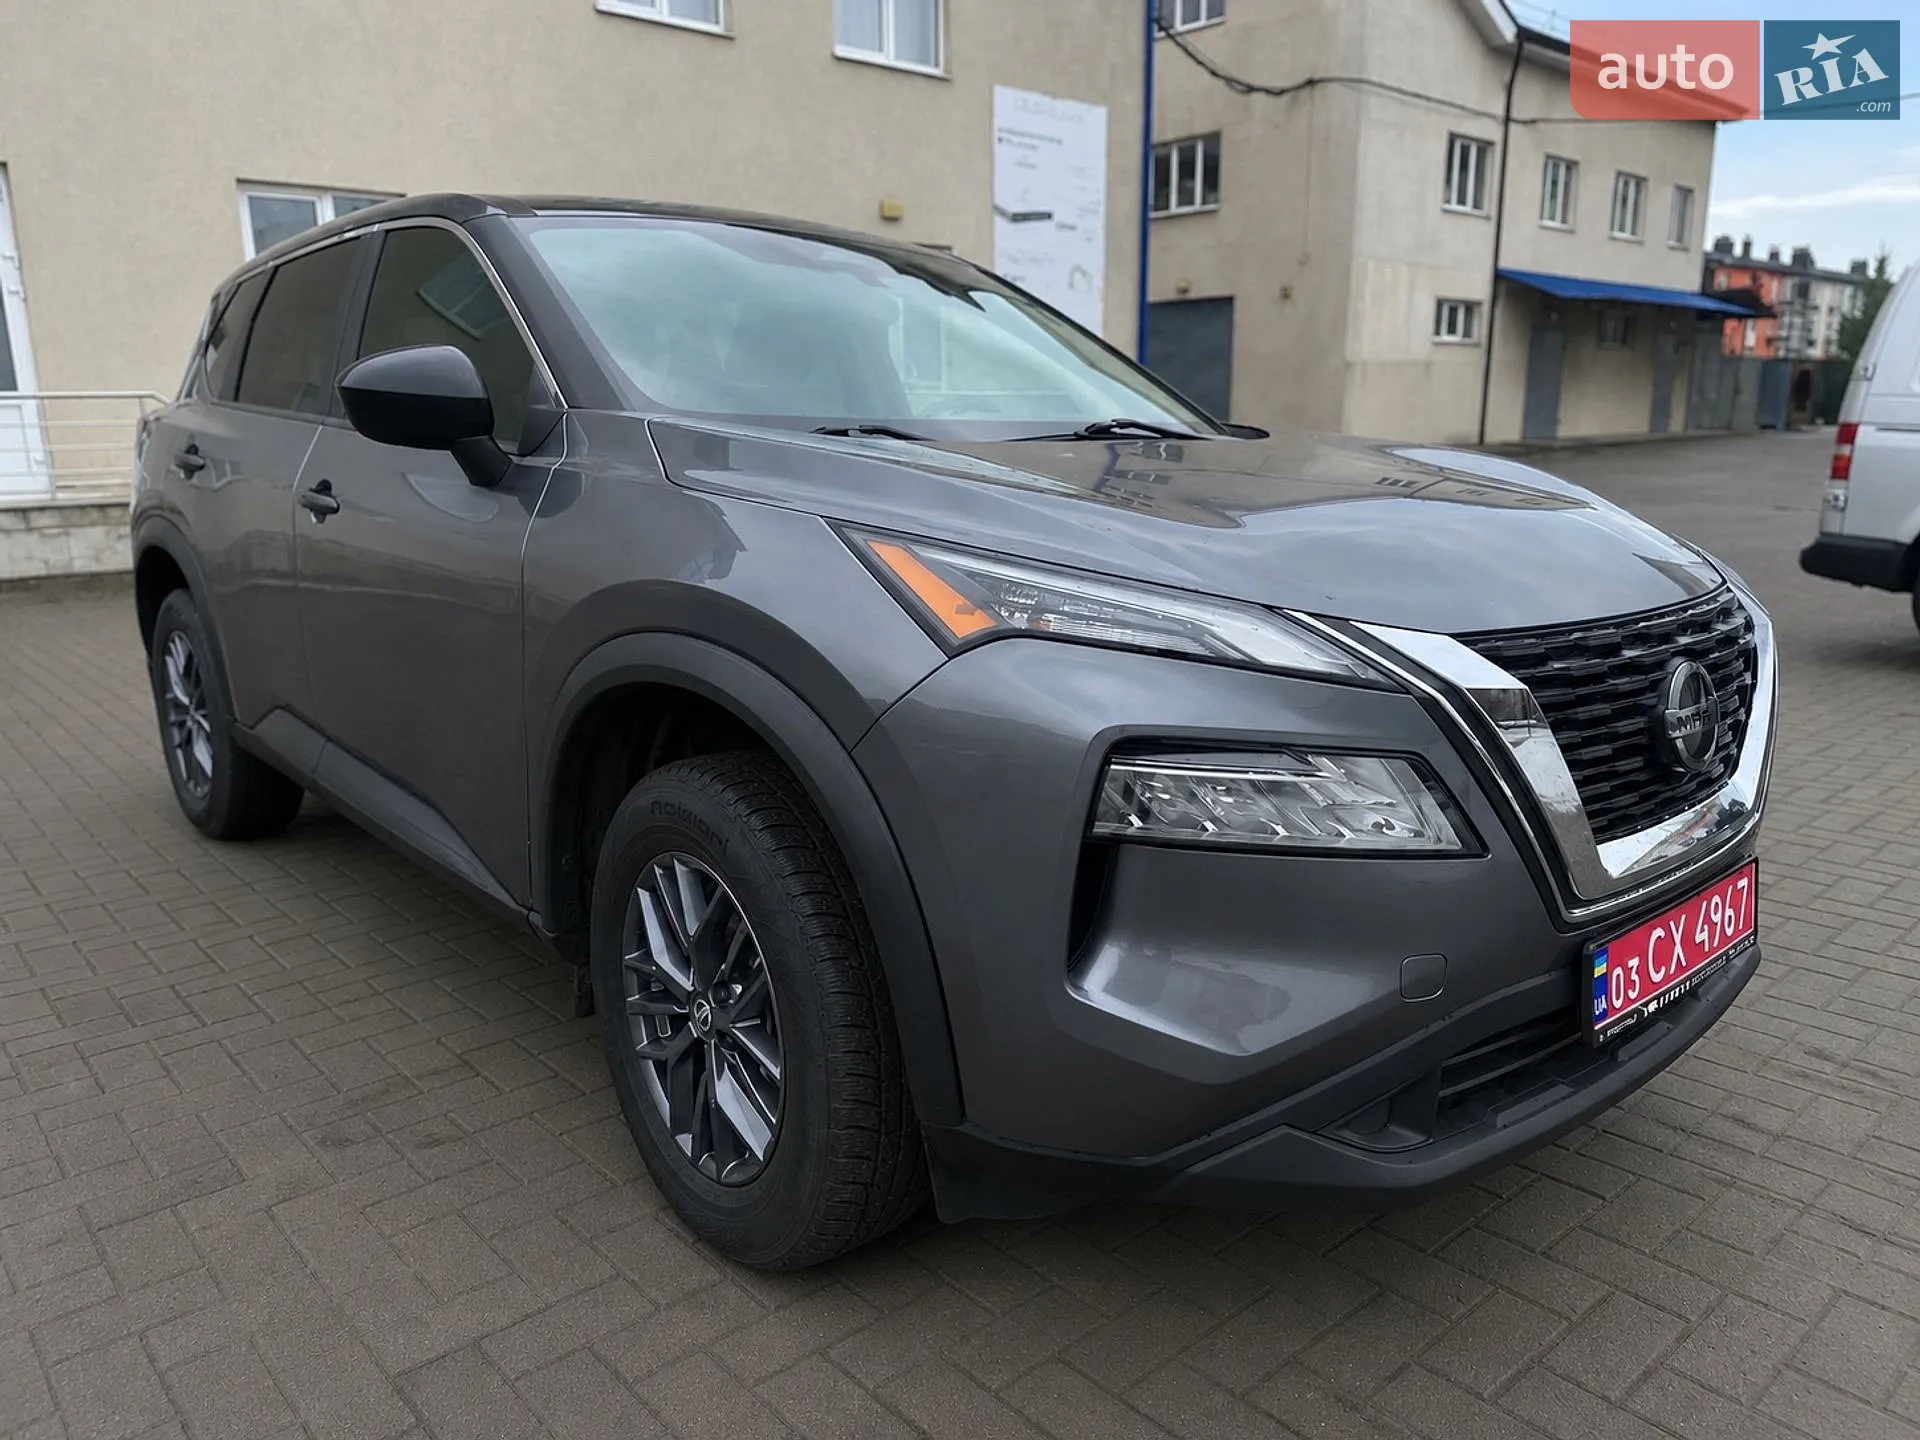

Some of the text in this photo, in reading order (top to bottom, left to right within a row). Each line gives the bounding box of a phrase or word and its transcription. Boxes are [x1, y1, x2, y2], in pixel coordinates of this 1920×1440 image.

[1611, 956, 1640, 1009] 03
[1647, 913, 1687, 984] CX
[1694, 876, 1749, 952] 4967
[1593, 994, 1608, 1016] UA
